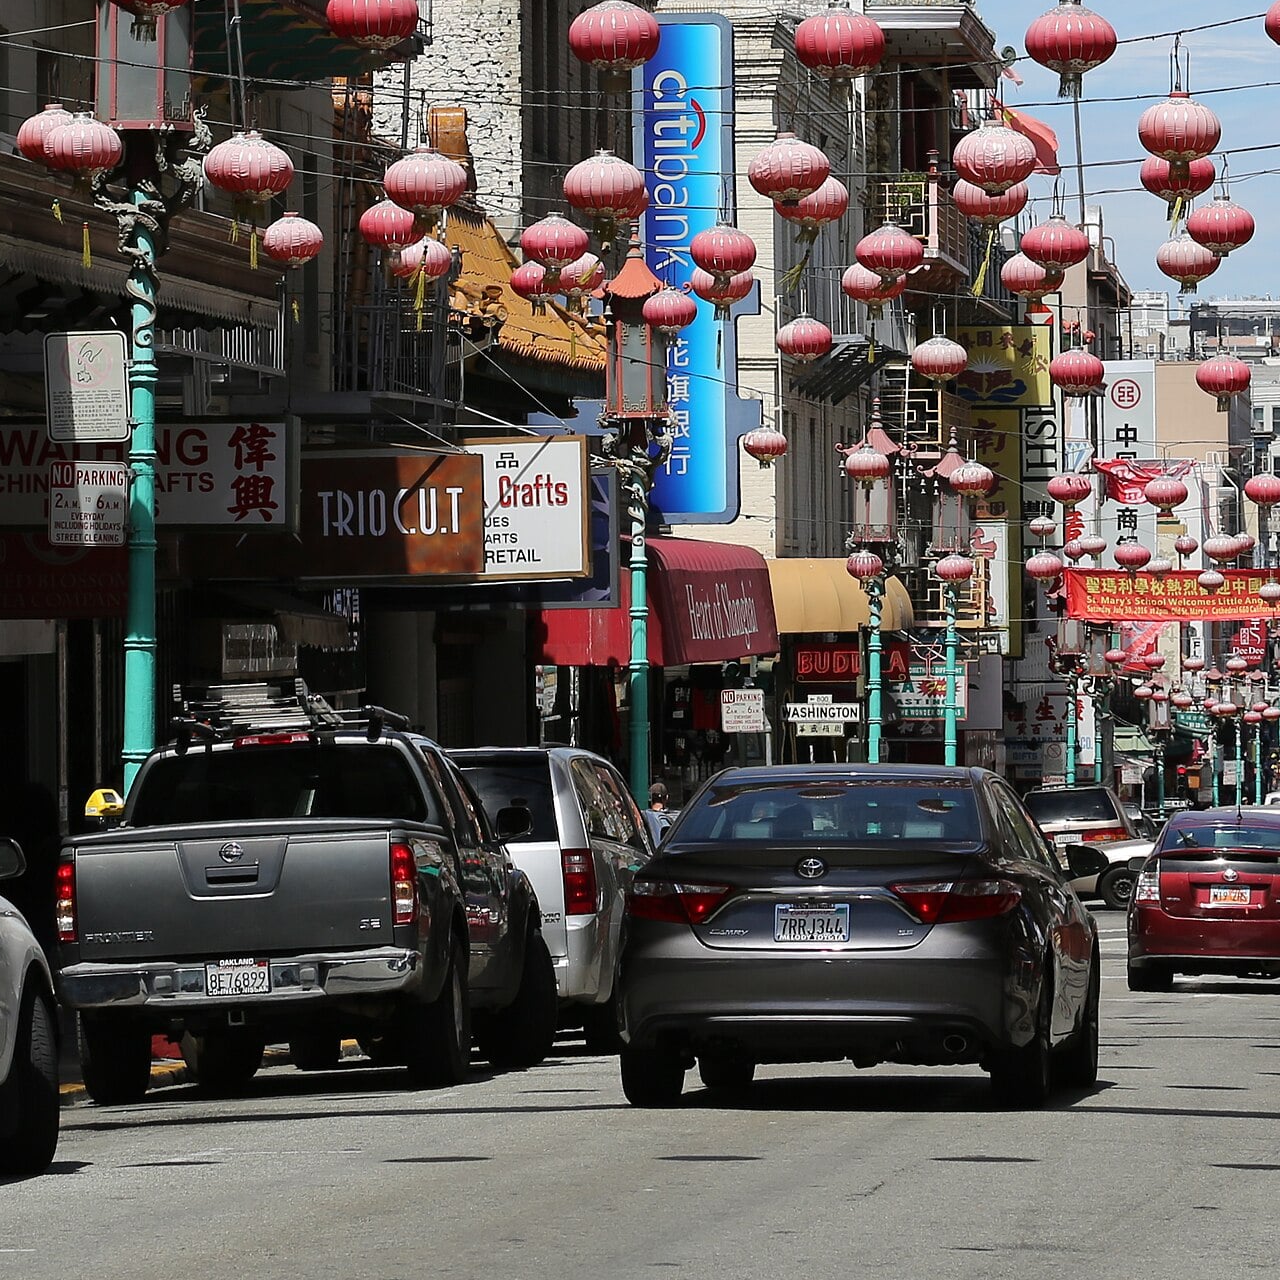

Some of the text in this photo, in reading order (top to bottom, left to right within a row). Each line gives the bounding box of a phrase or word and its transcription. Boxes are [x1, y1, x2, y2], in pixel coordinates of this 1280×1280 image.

[651, 68, 700, 271] citibank
[495, 452, 520, 469] 品
[52, 464, 124, 487] NO PARKING
[498, 474, 569, 508] Crafts
[71, 512, 105, 522] EVERYDAY
[317, 488, 387, 537] TRIO
[54, 521, 122, 531] INCLUDING HOLIDAYS
[56, 532, 120, 543] STREET CLEANING
[485, 549, 541, 564] RETAIL
[1100, 596, 1132, 606] Mary's
[1134, 597, 1167, 606] School
[1168, 597, 1217, 606] Welcomes
[1218, 597, 1243, 606] Little
[685, 580, 760, 650] Heart of Shanghai
[722, 692, 762, 703] NO PARKING
[782, 706, 858, 719] WASHINGTON
[709, 928, 750, 936] CAMRY
[779, 918, 844, 934] 7RRJ344
[85, 930, 156, 944] FRONTIER
[777, 933, 845, 941] MELODY TOYOTA
[219, 958, 255, 966] OAKLAND
[209, 971, 266, 990] 8E76899
